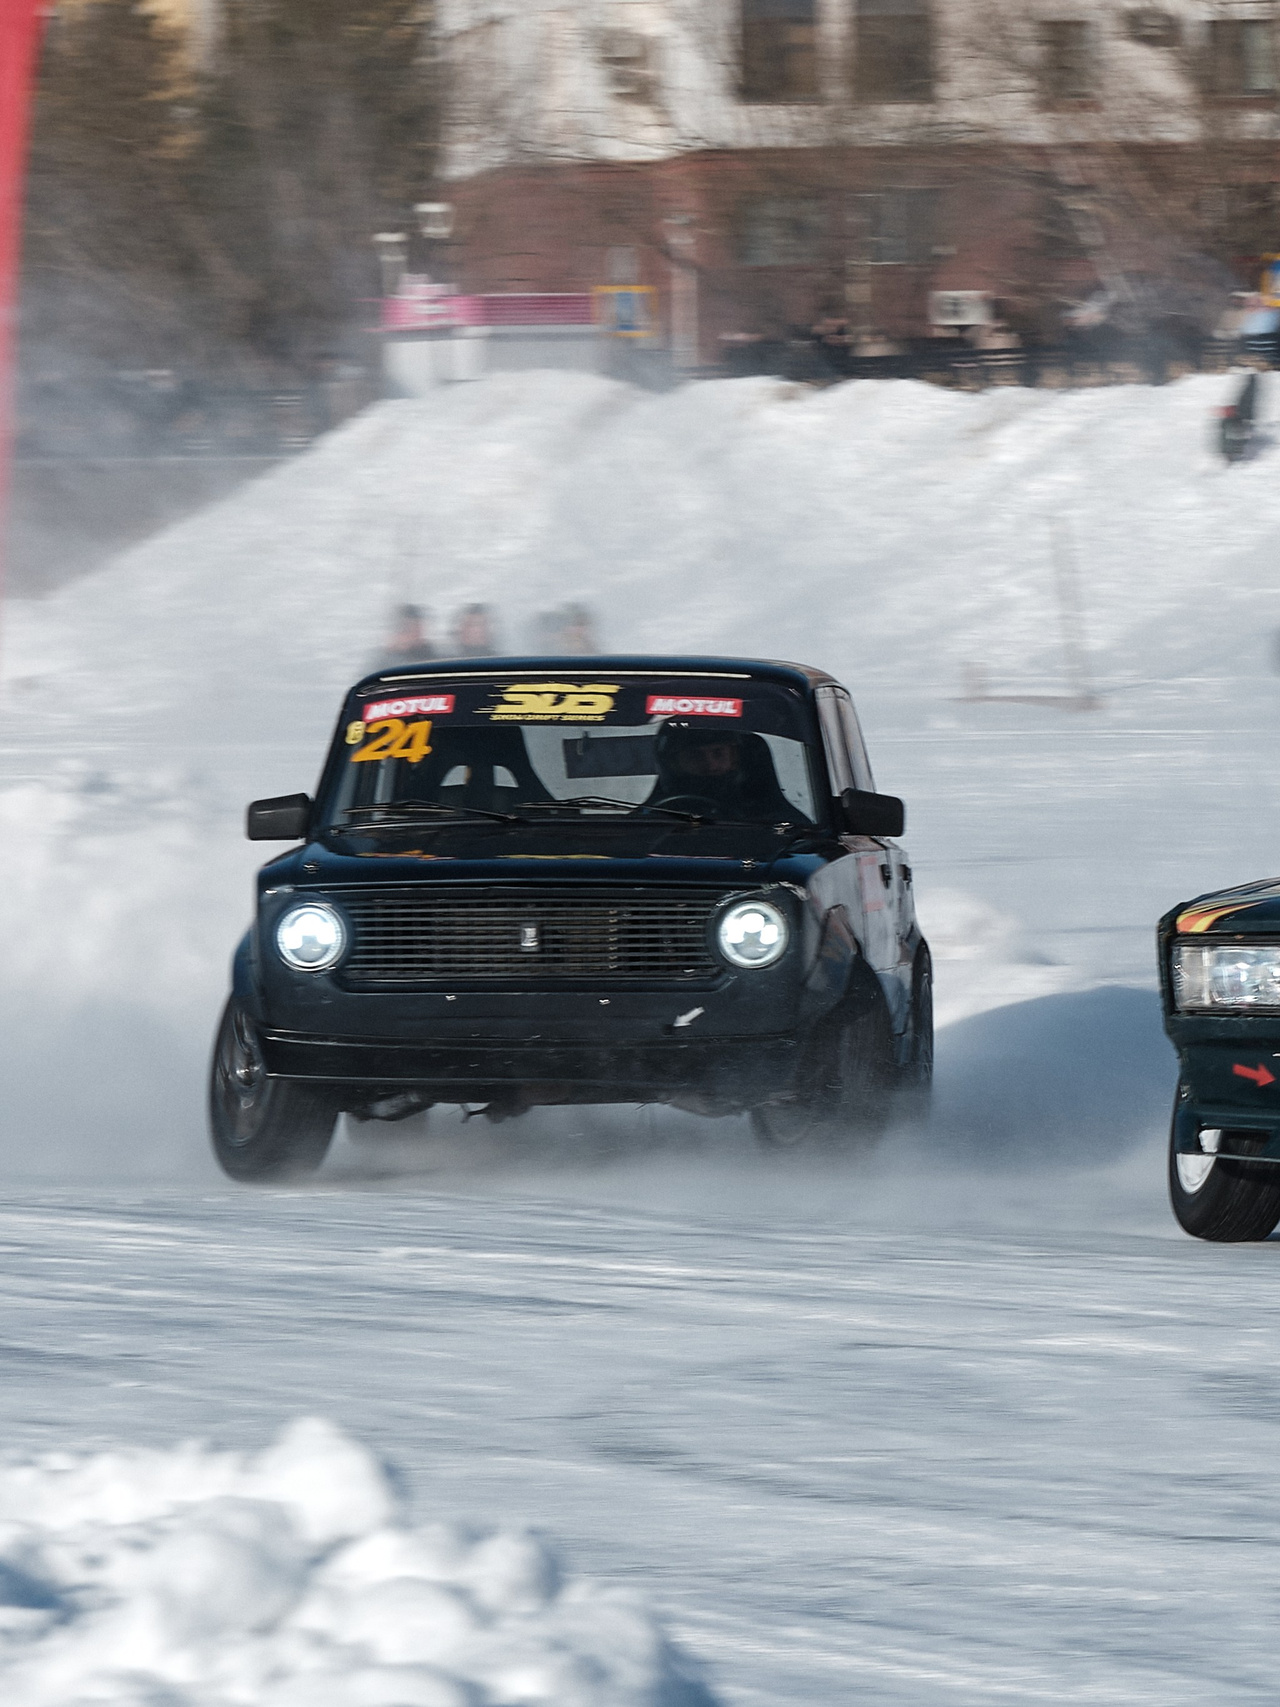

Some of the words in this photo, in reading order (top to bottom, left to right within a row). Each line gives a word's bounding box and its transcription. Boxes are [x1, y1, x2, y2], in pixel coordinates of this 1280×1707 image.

[365, 697, 450, 720] MOTUL
[649, 698, 738, 714] MOTUL
[349, 719, 433, 763] 24
